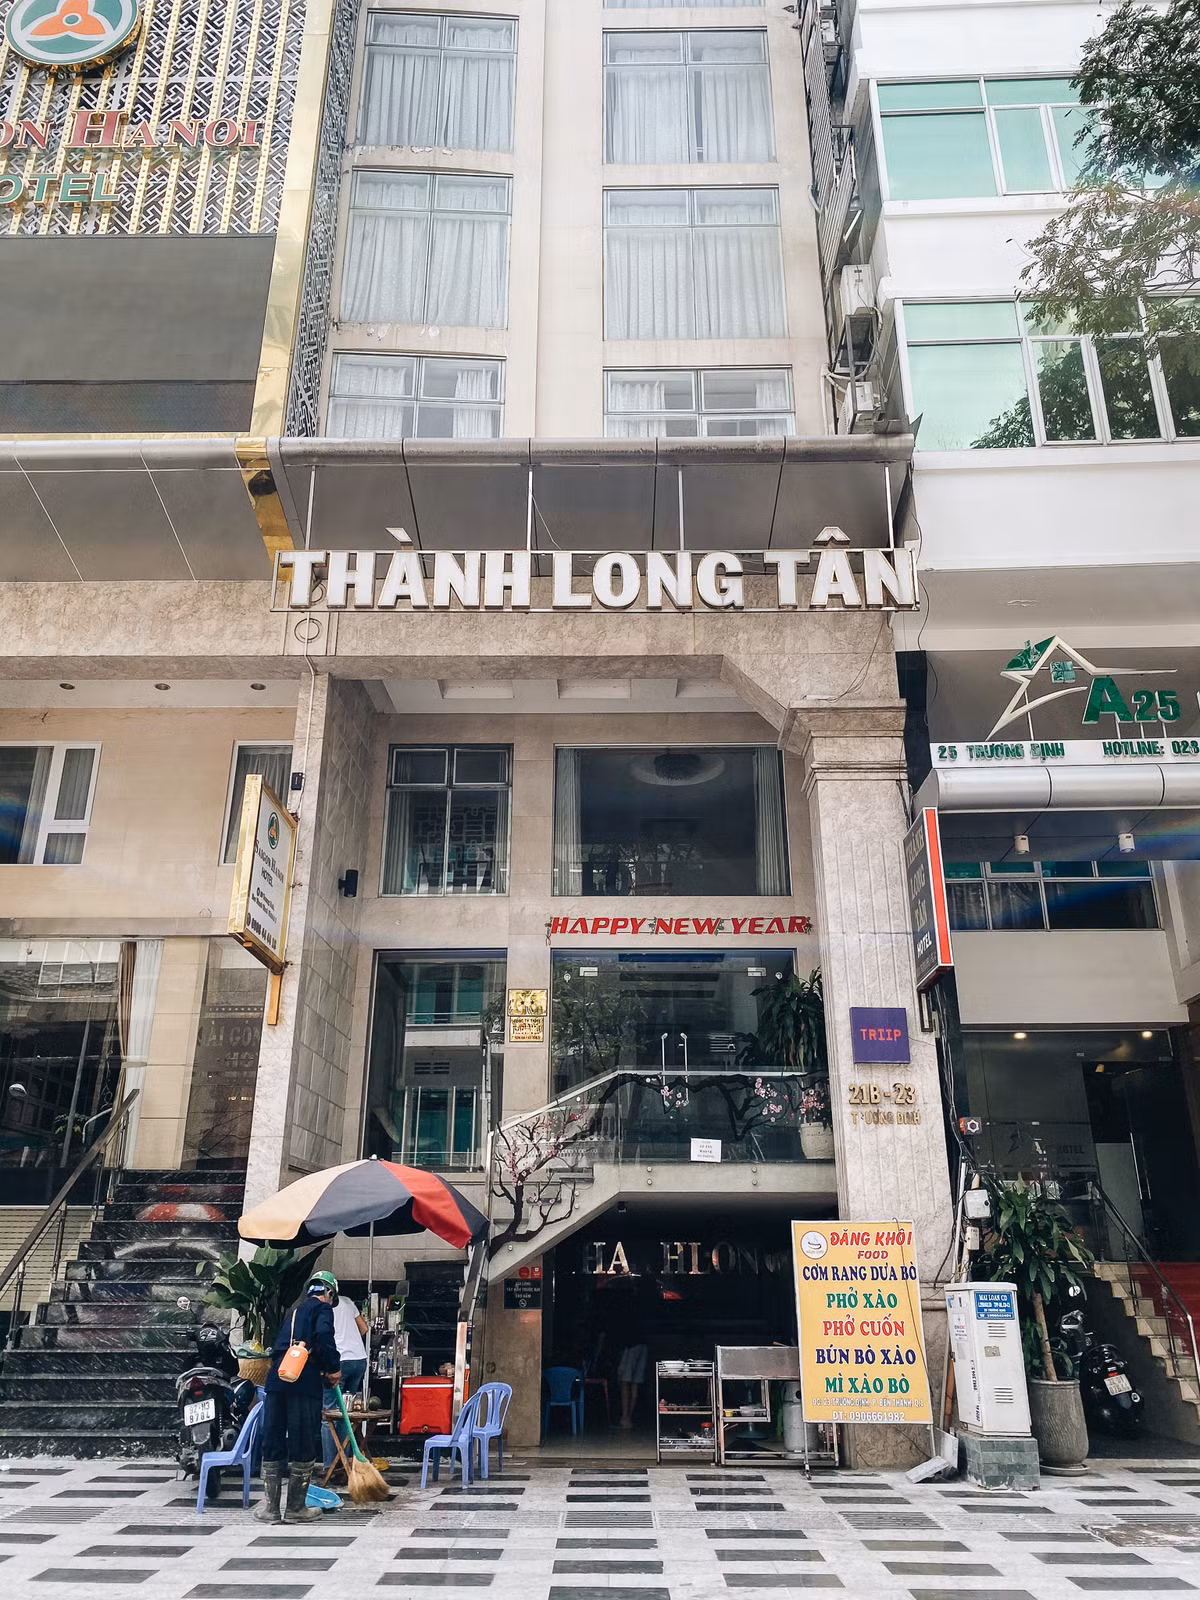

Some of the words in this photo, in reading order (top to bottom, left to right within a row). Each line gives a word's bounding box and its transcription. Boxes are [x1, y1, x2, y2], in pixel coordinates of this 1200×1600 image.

[65, 110, 262, 149] HANOI
[280, 527, 531, 608] THÀNH
[552, 551, 744, 609] LONG
[763, 526, 915, 609] TÂN
[1082, 676, 1180, 724] A25
[938, 745, 958, 760] 25
[1102, 741, 1165, 757] HOTLINE:
[1171, 740, 1199, 756] 028
[550, 917, 647, 935] HAPPY
[655, 917, 721, 935] NEW
[732, 915, 808, 934] YEAR
[860, 1029, 901, 1042] TRIIP
[830, 1229, 870, 1246] ĐĂNG
[875, 1229, 912, 1246] KHÔI
[857, 1250, 888, 1259] FOOD
[802, 1263, 828, 1281] CƠM
[831, 1266, 867, 1281] RANG
[870, 1262, 898, 1281] DƯA
[900, 1262, 917, 1281] BÒ
[826, 1286, 858, 1308] PHỞ
[863, 1289, 897, 1308] XÀO
[823, 1314, 855, 1336] PHỞ
[860, 1313, 905, 1336] CUỐN
[816, 1344, 849, 1364] BÚN
[854, 1344, 876, 1364] BÒ
[880, 1344, 916, 1364] XÀO
[825, 1372, 843, 1393] MÌ
[848, 1372, 883, 1393] XÀO
[888, 1373, 910, 1393] BÒ
[849, 1411, 905, 1421] 0906661982
